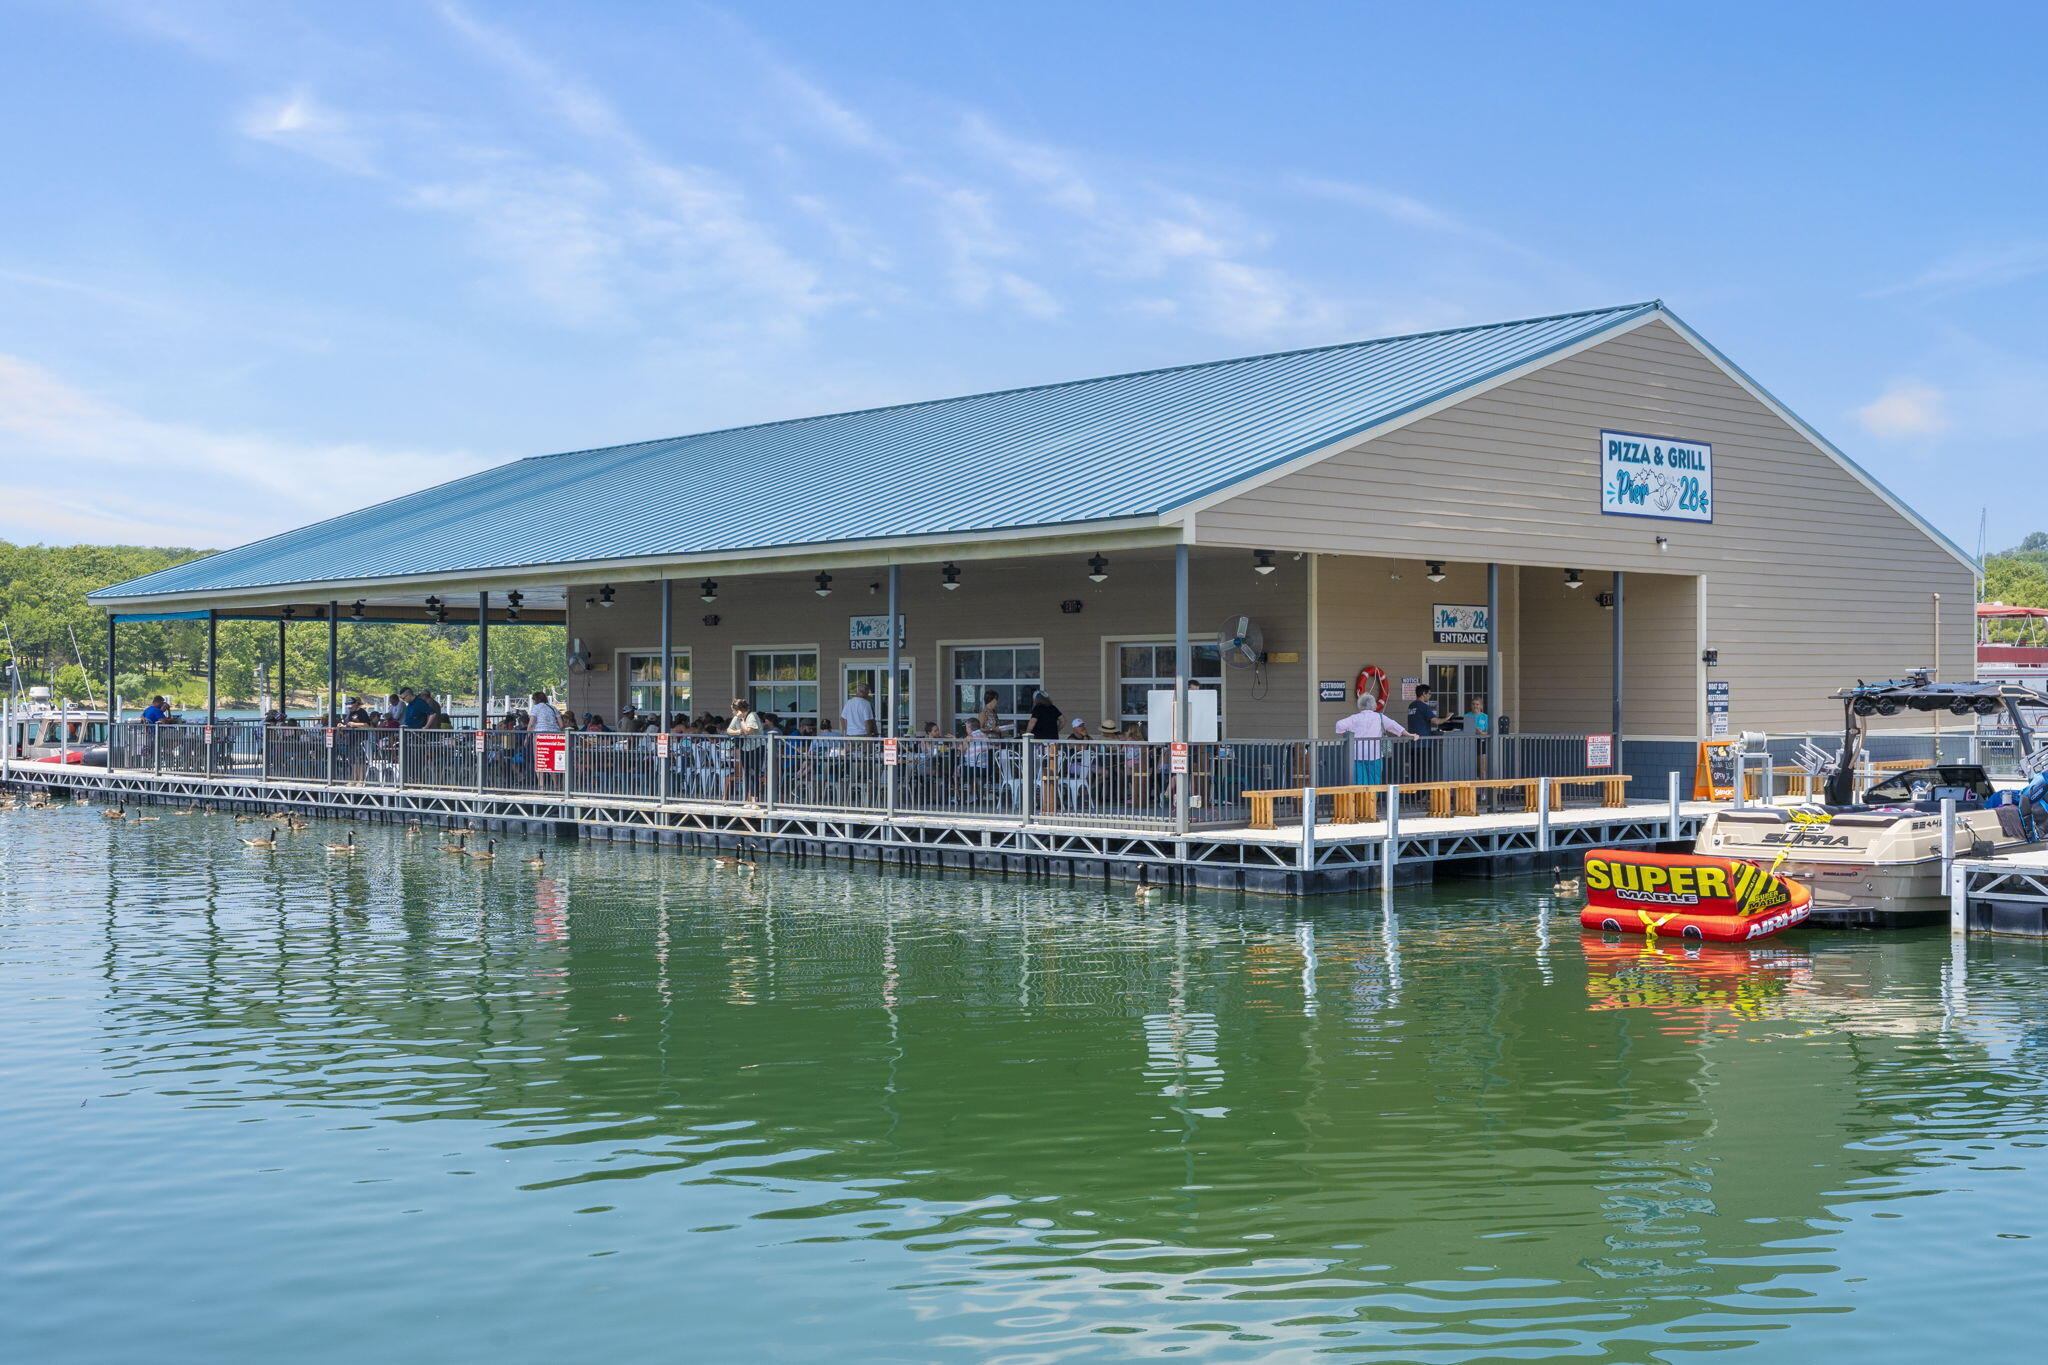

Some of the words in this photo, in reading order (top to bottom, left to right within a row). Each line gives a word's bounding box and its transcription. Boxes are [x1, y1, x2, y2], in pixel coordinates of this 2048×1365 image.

[1608, 439, 1651, 465] PIZZA
[1653, 445, 1664, 467] &
[1667, 446, 1706, 472] GRILL
[1616, 468, 1650, 506] Pier
[1678, 475, 1700, 512] 28
[1440, 609, 1458, 629] Pier
[1472, 610, 1485, 630] 28
[850, 640, 878, 650] ENTER
[1440, 633, 1486, 644] ENTRANCE
[1708, 683, 1718, 691] BOAT
[1718, 683, 1729, 691] SLIPS
[1761, 832, 1850, 847] SUPRA
[1585, 858, 1731, 899] SUPER
[1616, 888, 1699, 905] MABLE
[1748, 894, 1787, 910] MABLE
[1755, 890, 1779, 902] SUPER
